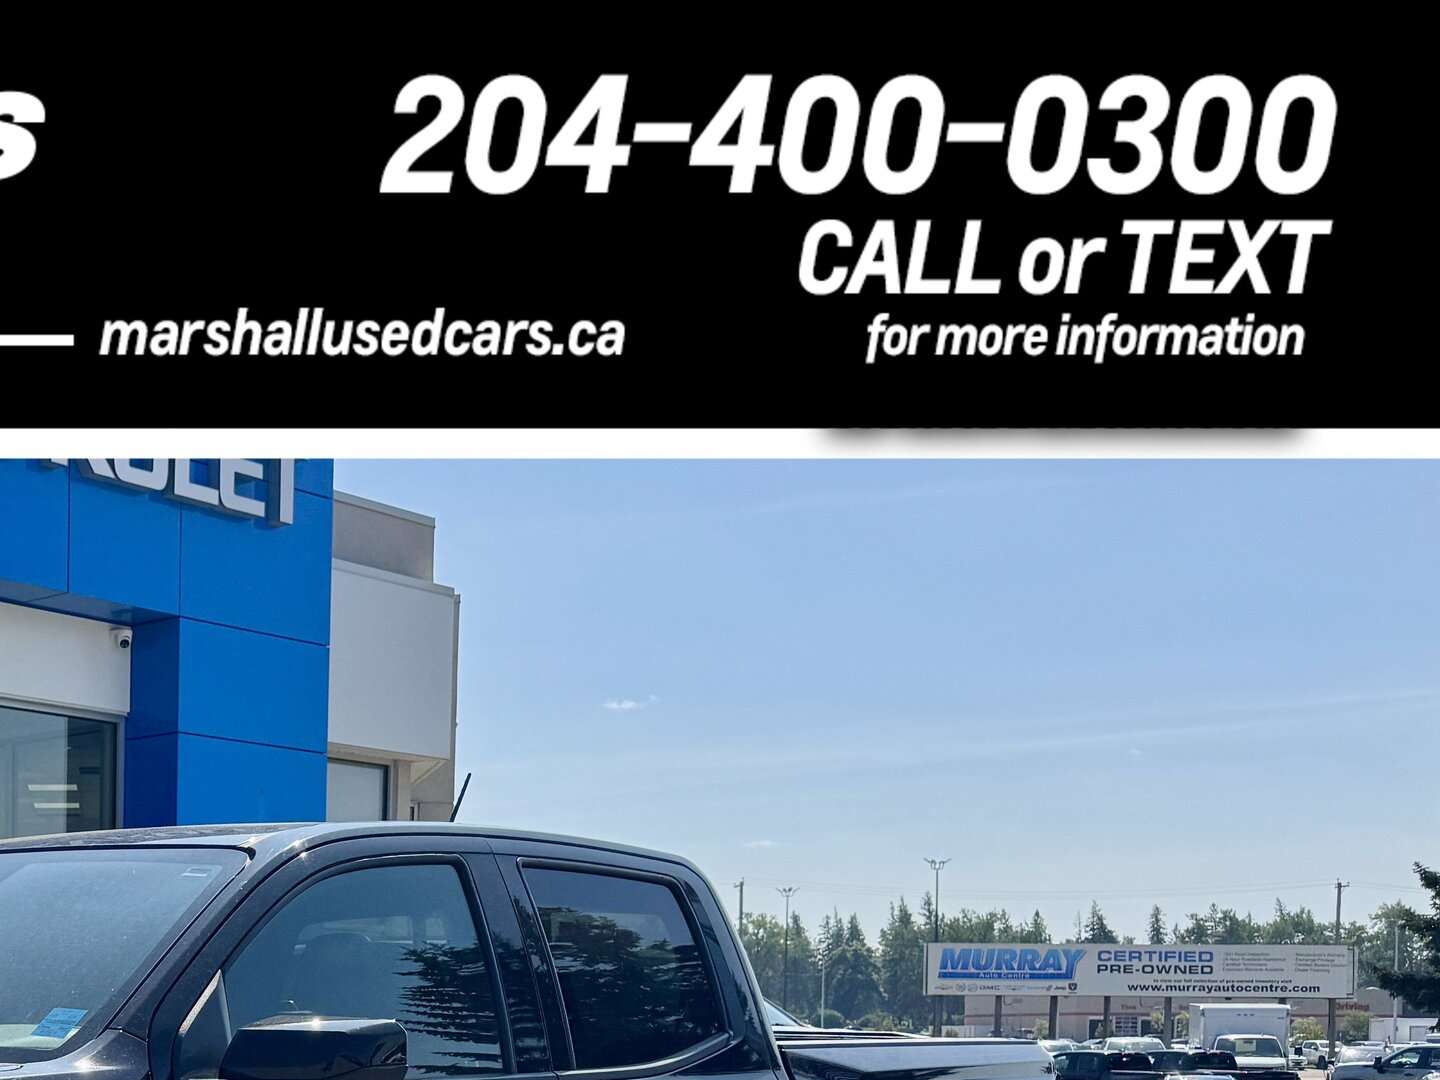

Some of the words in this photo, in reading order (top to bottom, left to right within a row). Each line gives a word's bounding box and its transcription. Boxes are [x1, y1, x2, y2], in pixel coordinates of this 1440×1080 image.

[939, 947, 1087, 973] MURRAY
[1097, 950, 1214, 963] CERTIFIED
[1097, 964, 1214, 975] PRE-OWNED
[1128, 982, 1321, 995] www.murrayautocentre.com
